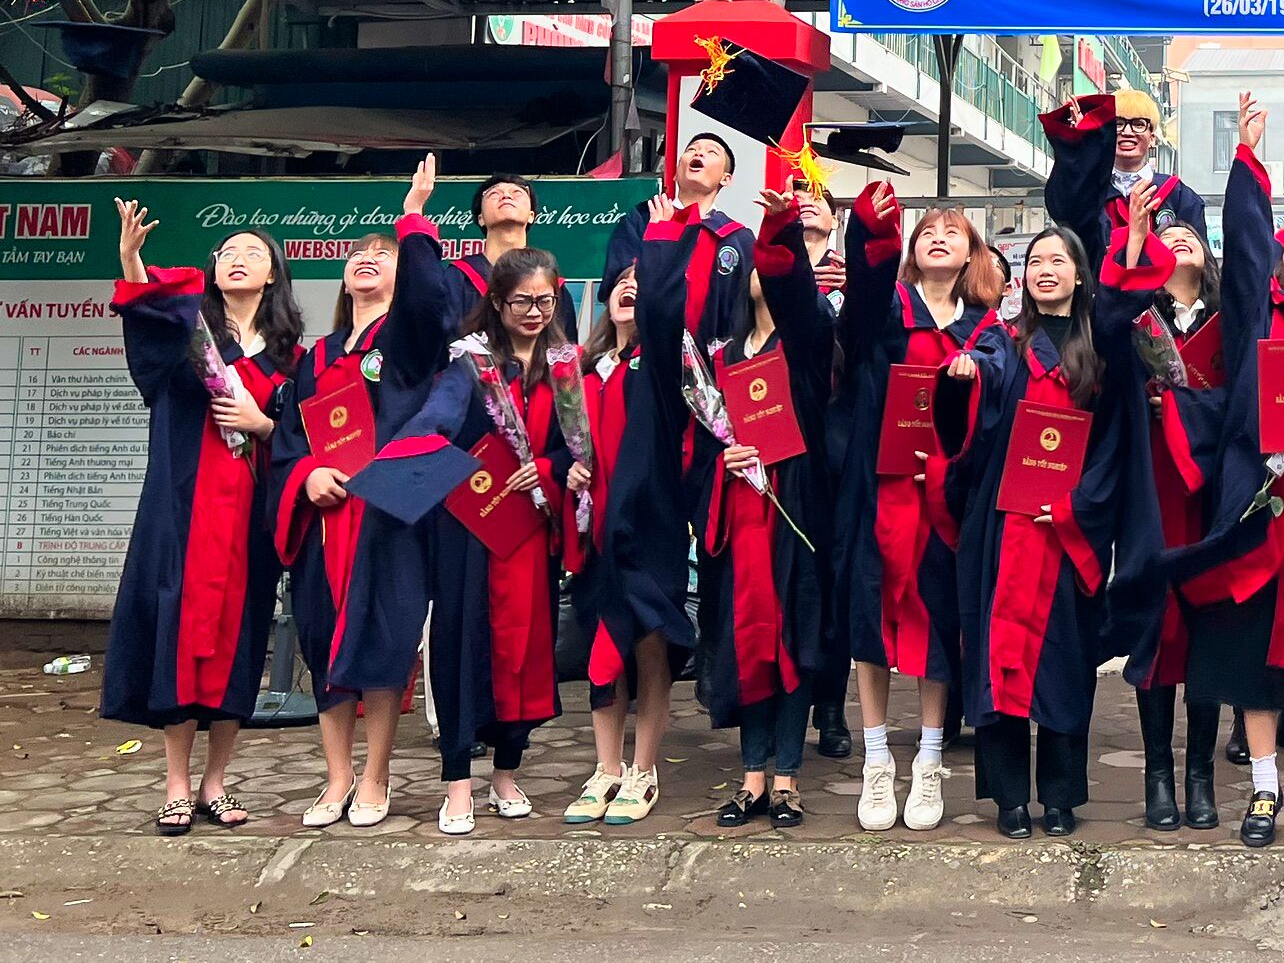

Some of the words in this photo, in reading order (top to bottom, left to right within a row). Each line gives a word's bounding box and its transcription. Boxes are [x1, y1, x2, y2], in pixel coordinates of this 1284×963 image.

[15, 203, 92, 240] NAM
[195, 203, 247, 228] Đào
[248, 207, 279, 228] tạo
[280, 206, 336, 235] những
[556, 205, 591, 229] học
[284, 238, 353, 260] WEBSIT
[33, 250, 55, 264] TAY
[56, 250, 86, 267] BẠN
[5, 297, 42, 319] VẤN
[46, 297, 105, 319] TUYỂN
[30, 347, 42, 356] TT
[73, 346, 91, 356] CÁC
[28, 375, 38, 384] 16
[23, 430, 34, 439] 20
[21, 458, 31, 467] 22
[69, 458, 86, 467] Anh
[19, 486, 29, 494] 24
[17, 500, 28, 508] 25
[65, 500, 88, 510] Trung
[17, 514, 27, 522] 26
